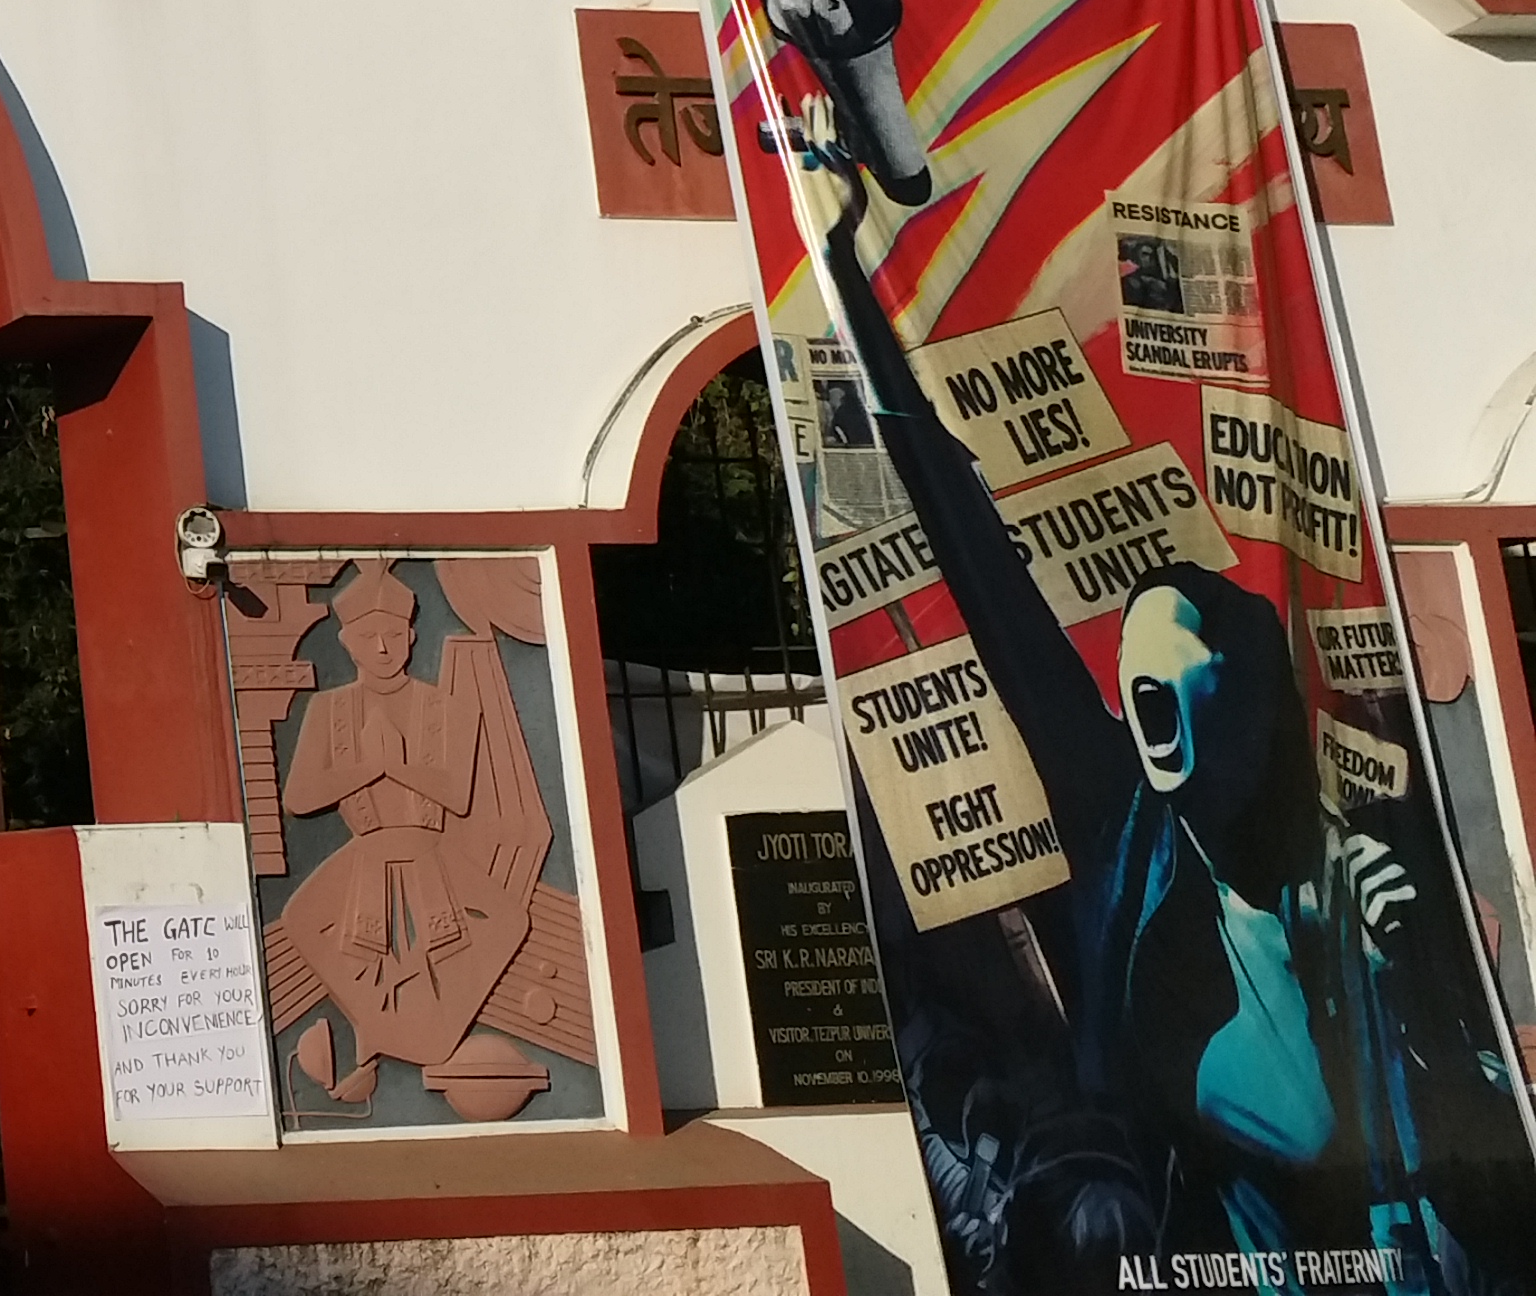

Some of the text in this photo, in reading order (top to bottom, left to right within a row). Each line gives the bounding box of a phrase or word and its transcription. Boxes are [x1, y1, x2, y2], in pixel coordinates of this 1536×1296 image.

[1112, 201, 1241, 233] RESISTANCE
[1124, 318, 1208, 346] UNIVERSITY
[809, 348, 828, 365] NO
[1125, 341, 1249, 372] SCANDAL ERUPTS
[945, 338, 1085, 421] NO MORE
[1004, 398, 1090, 467] LIES!
[1213, 465, 1276, 515] NOT
[1004, 466, 1198, 567] STUDENTS
[1341, 621, 1398, 650] FUTUR
[851, 659, 988, 734] STUDENTS
[891, 711, 989, 773] UNITE!
[925, 783, 1004, 841] FIGHT
[757, 833, 808, 861] JYOTI
[909, 817, 1060, 897] OPPRESSION!
[787, 880, 856, 895] INAUGURATED
[817, 902, 832, 915] BY
[104, 918, 149, 947] THE
[223, 913, 251, 932] WILL
[780, 924, 798, 937] HIS
[106, 947, 220, 971] OPEN FOR 10
[754, 949, 778, 970] SRI
[110, 964, 253, 990] MINUTES EVERY HOUR
[784, 978, 842, 998] PRESIDENT
[844, 978, 858, 994] OF
[117, 988, 254, 1019] SORRY FOR YOUR
[832, 1003, 844, 1017] &
[122, 1009, 258, 1044] INCONVENIENCE
[114, 1045, 246, 1077] AND THANK YOU
[835, 1049, 853, 1063] ON
[115, 1077, 263, 1108] FOR YOUR SUPPORT
[793, 1071, 853, 1087] NOVEMBER
[1118, 1247, 1406, 1291] ALL STUDENTS' FRATERNITY
